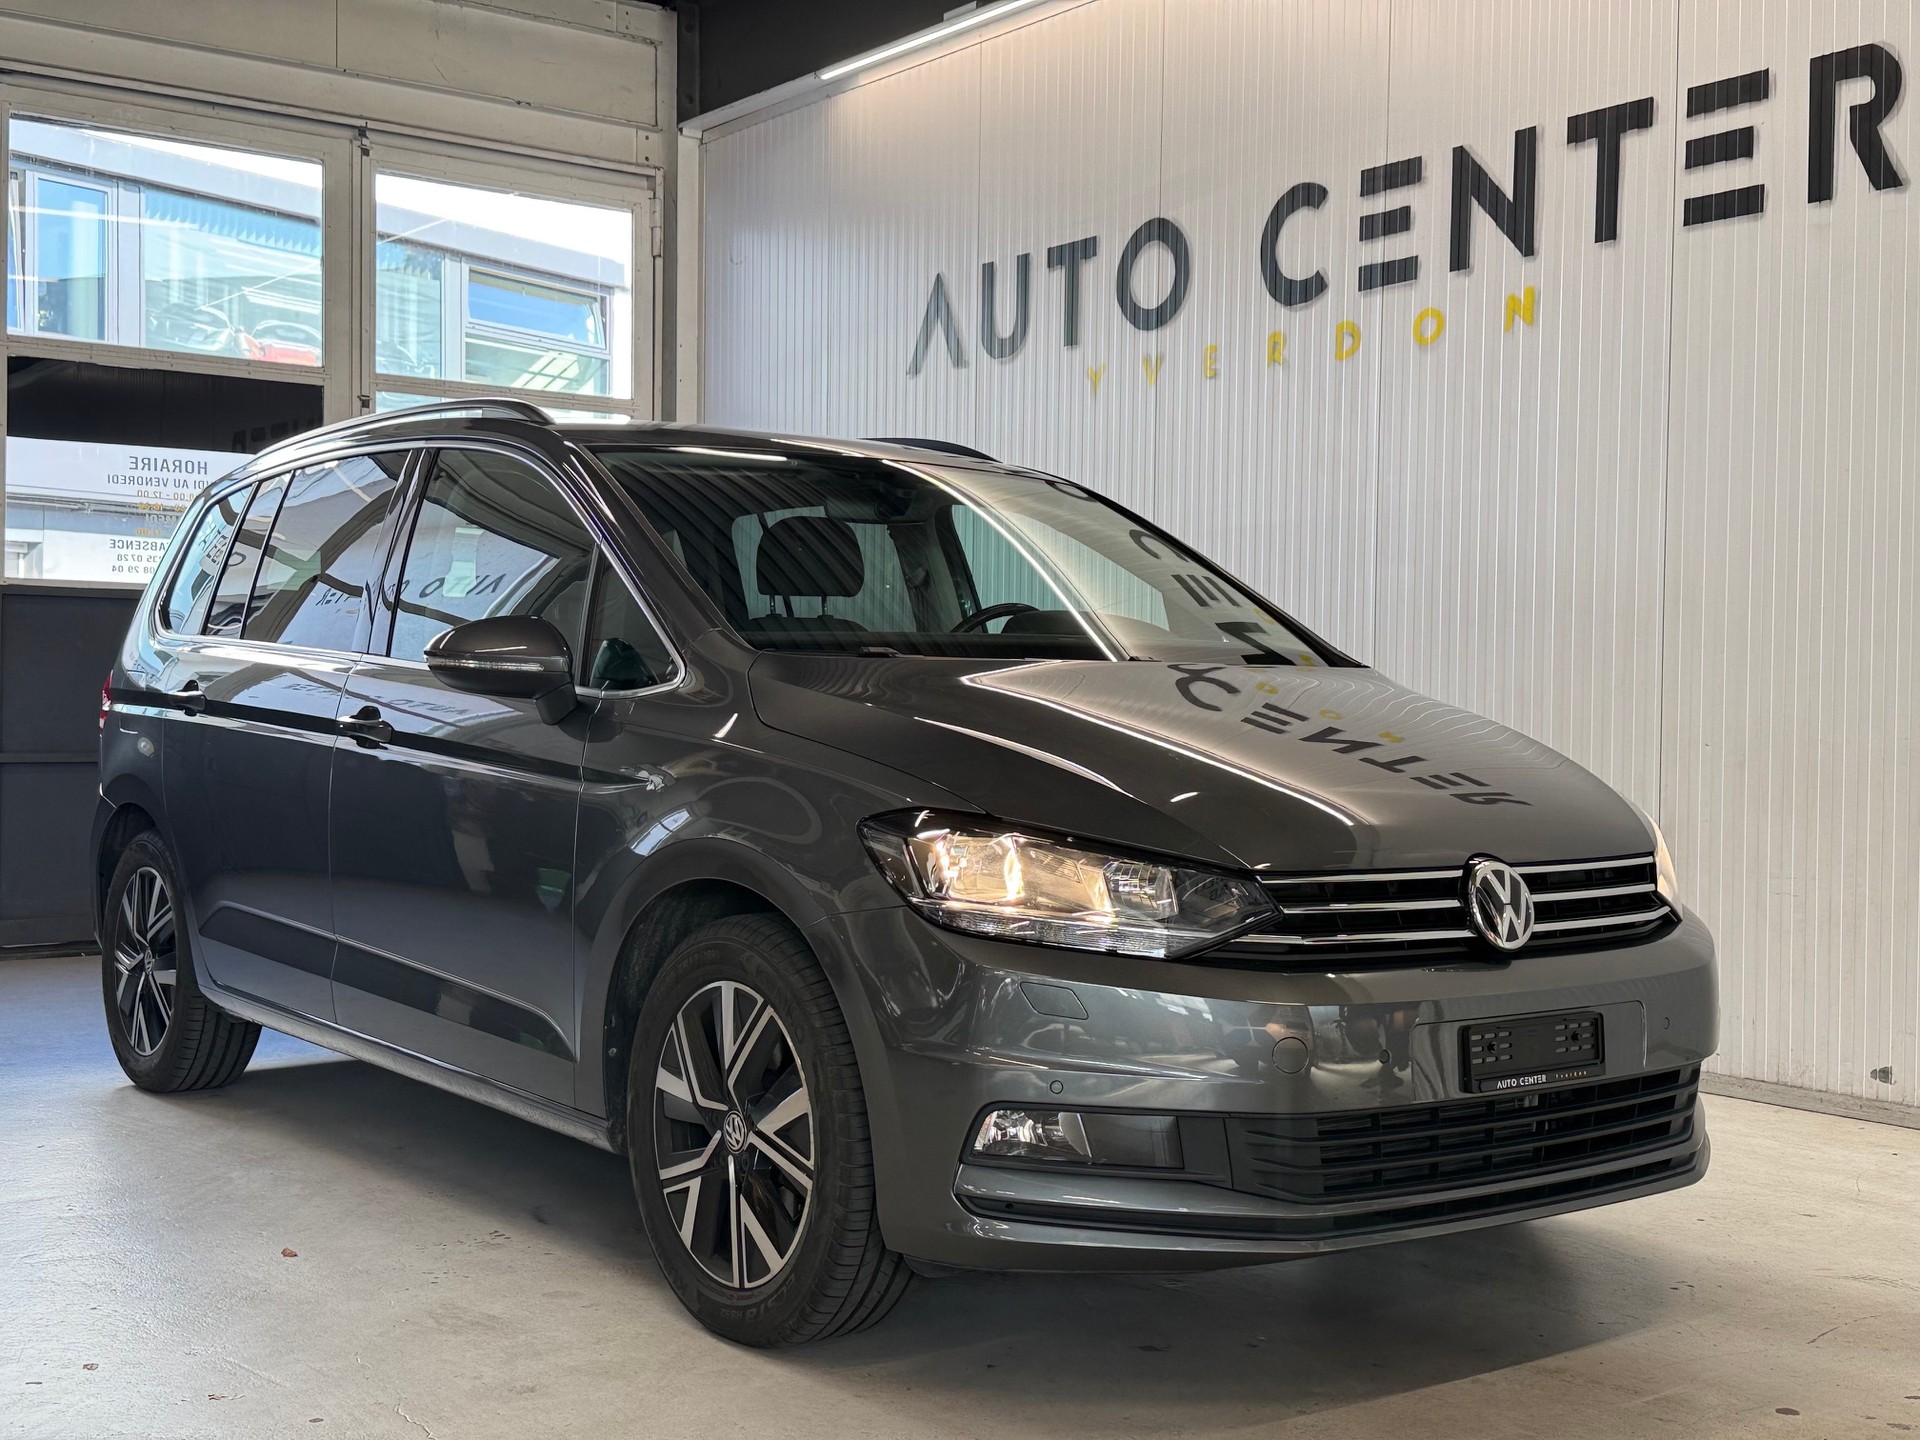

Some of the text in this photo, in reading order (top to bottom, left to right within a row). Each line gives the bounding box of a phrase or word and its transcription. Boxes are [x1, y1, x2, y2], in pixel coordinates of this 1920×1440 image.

[907, 42, 1906, 376] AUTO CENTER
[1087, 286, 1536, 395] YVERDON
[1496, 1079, 1517, 1089] AUTO
[1519, 1074, 1547, 1085] CENTER
